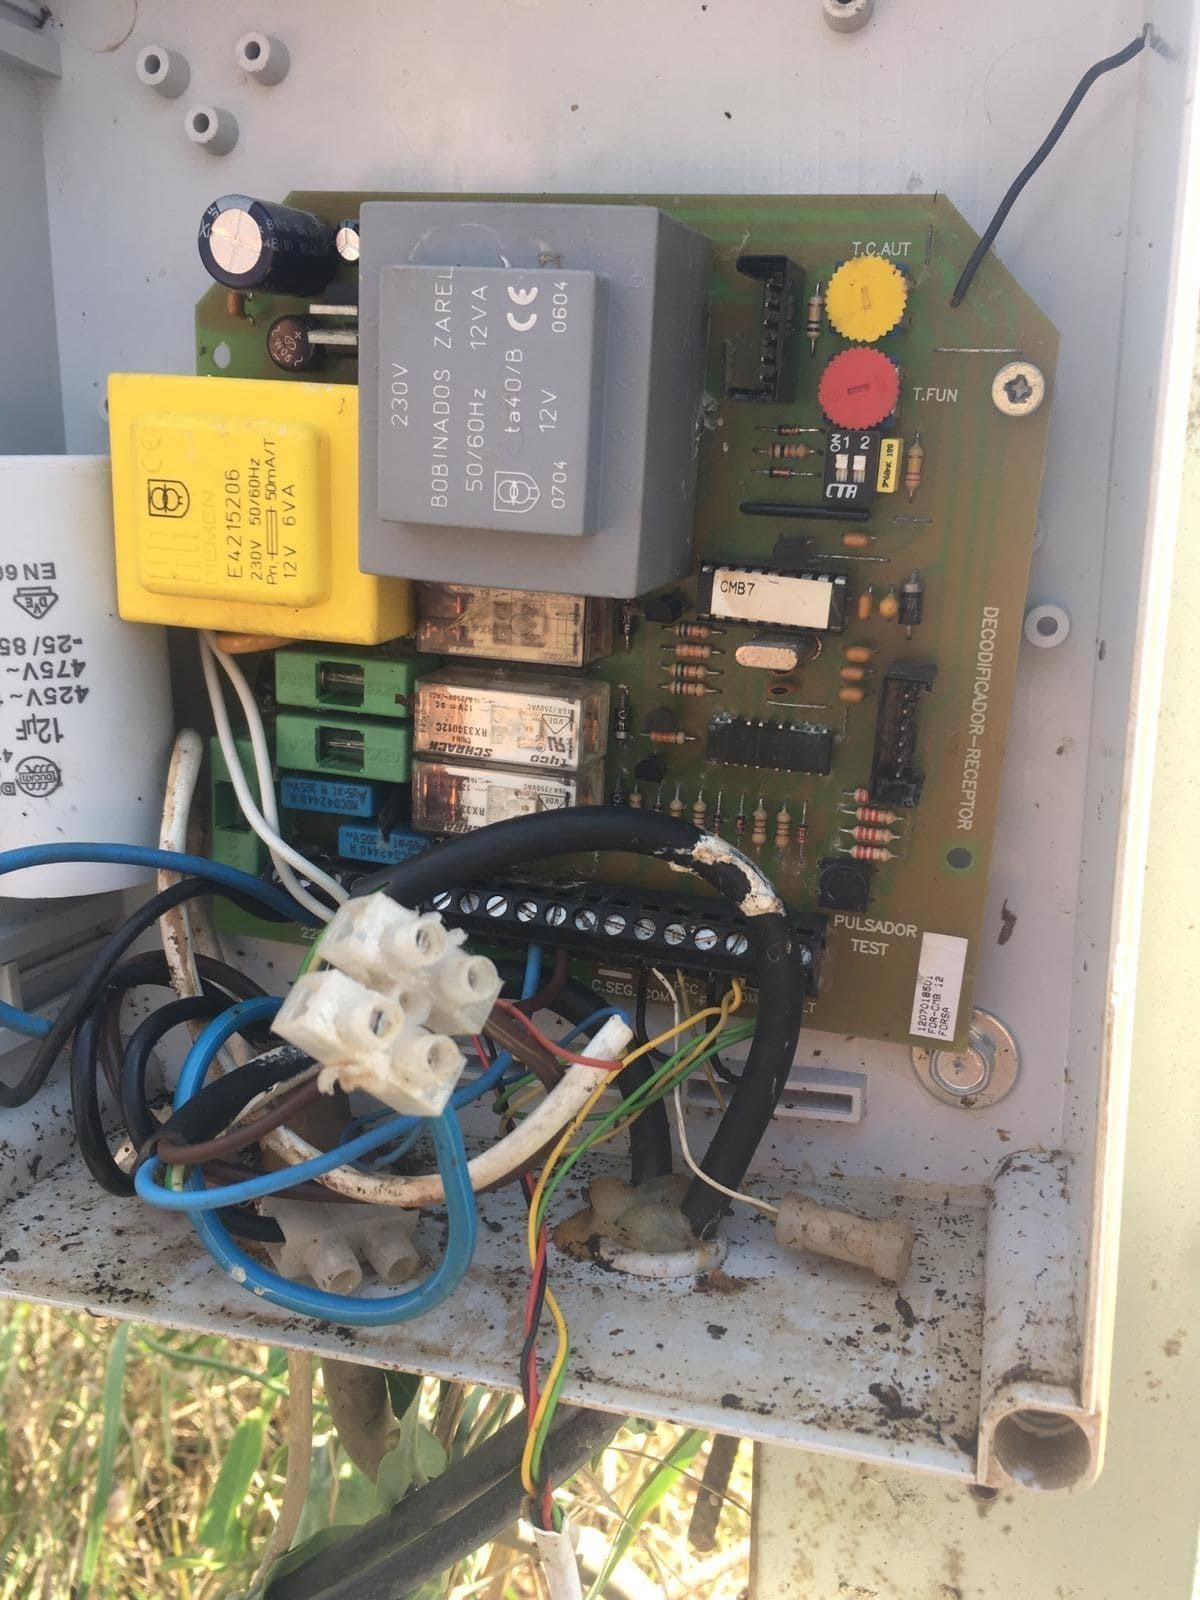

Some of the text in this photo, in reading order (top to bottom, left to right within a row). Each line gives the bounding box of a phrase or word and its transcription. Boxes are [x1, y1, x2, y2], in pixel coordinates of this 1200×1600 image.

[852, 242, 911, 257] T.C.AUT
[391, 362, 408, 427] 230V
[431, 266, 453, 508] BOBINADOS ZAREL
[465, 285, 488, 492] 50/60Hz 12VA
[504, 349, 523, 433] ta40/B
[551, 281, 569, 509] 0704 0604
[912, 387, 958, 403] T.FUN
[539, 389, 558, 432] 12V
[830, 434, 870, 452] ON 1 2
[264, 437, 277, 500] 50mA/T
[224, 469, 243, 578] E4215206
[249, 458, 263, 581] 230V 50/60Hz
[23, 562, 56, 580] EN
[282, 546, 297, 579] 12V
[720, 580, 755, 596] CMB7
[436, 722, 488, 737] RX334012C
[834, 914, 917, 938] PULSADOR
[850, 939, 889, 956] TEST
[591, 978, 637, 997] C.SEG.
